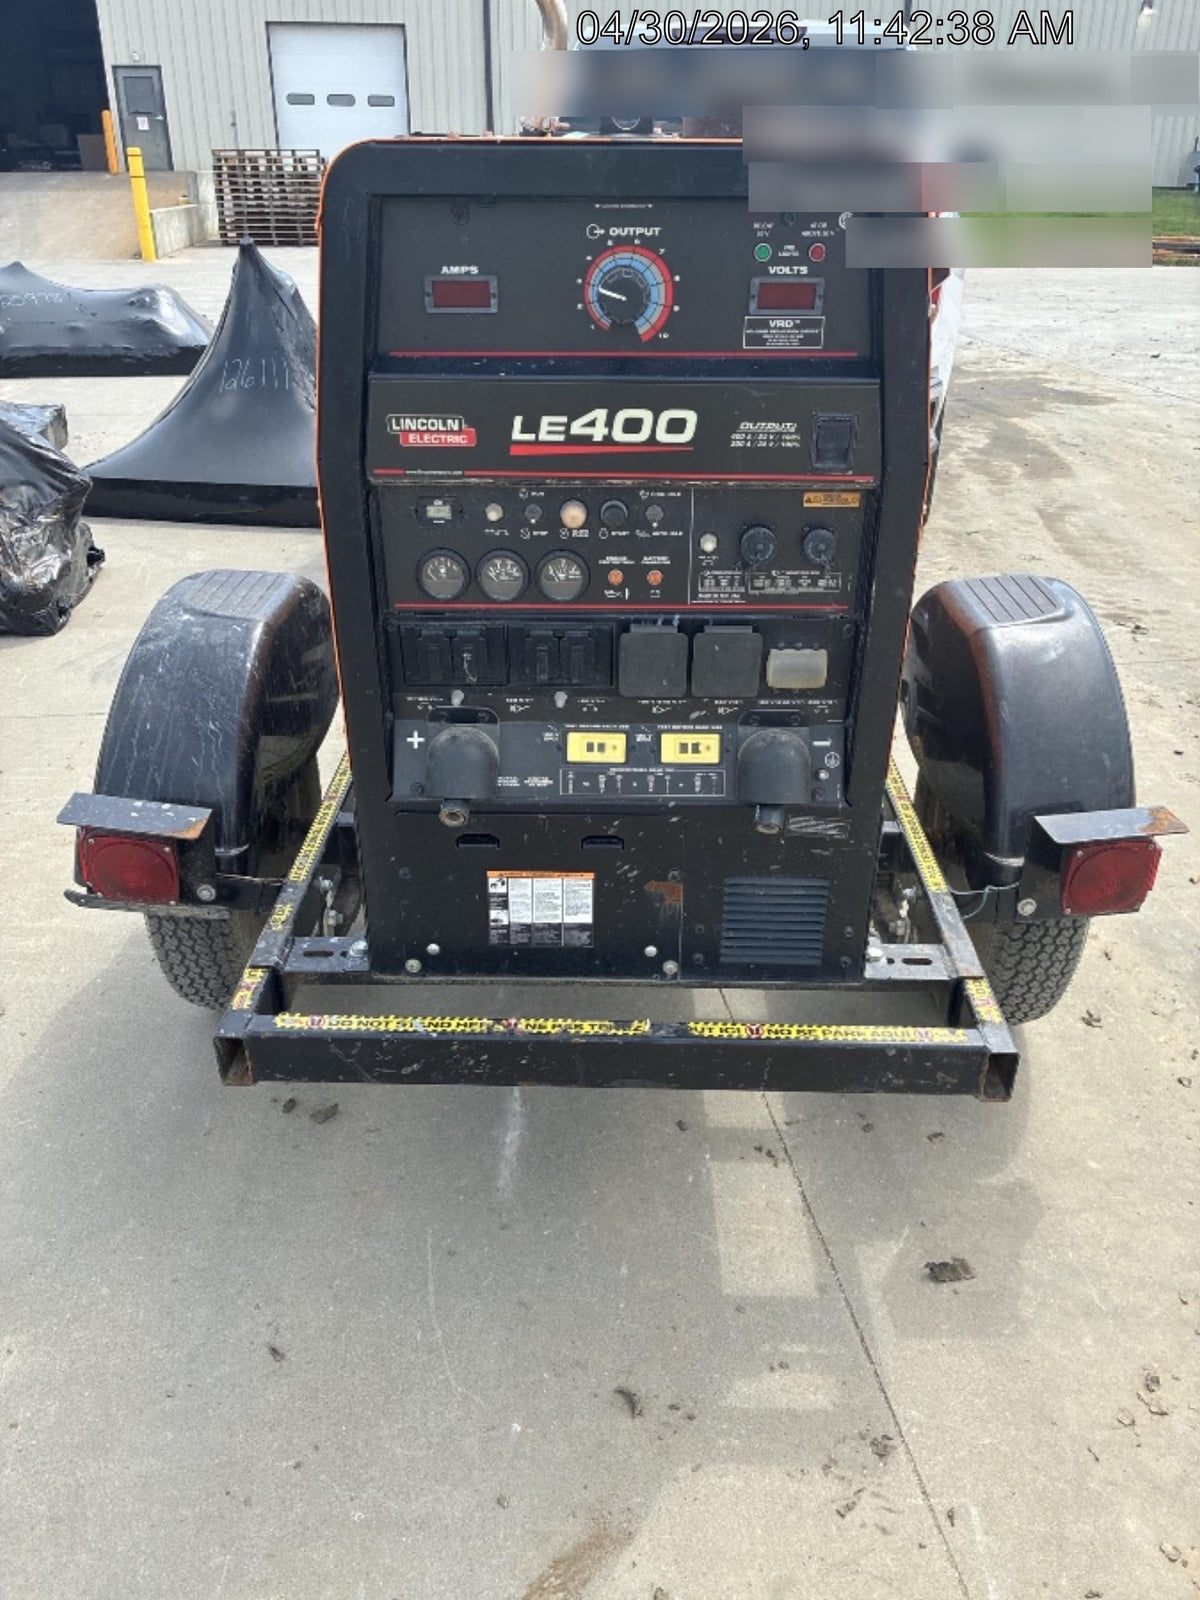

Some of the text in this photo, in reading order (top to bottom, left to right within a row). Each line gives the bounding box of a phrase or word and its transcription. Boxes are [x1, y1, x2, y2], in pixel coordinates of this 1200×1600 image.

[609, 227, 662, 236] OUTPUT
[441, 265, 479, 275] AMPS
[768, 266, 808, 275] VOLTS
[391, 417, 461, 431] LINCOLN
[511, 408, 698, 443] LE400
[408, 433, 468, 444] ELECTRIC
[357, 1020, 391, 1028] NOT
